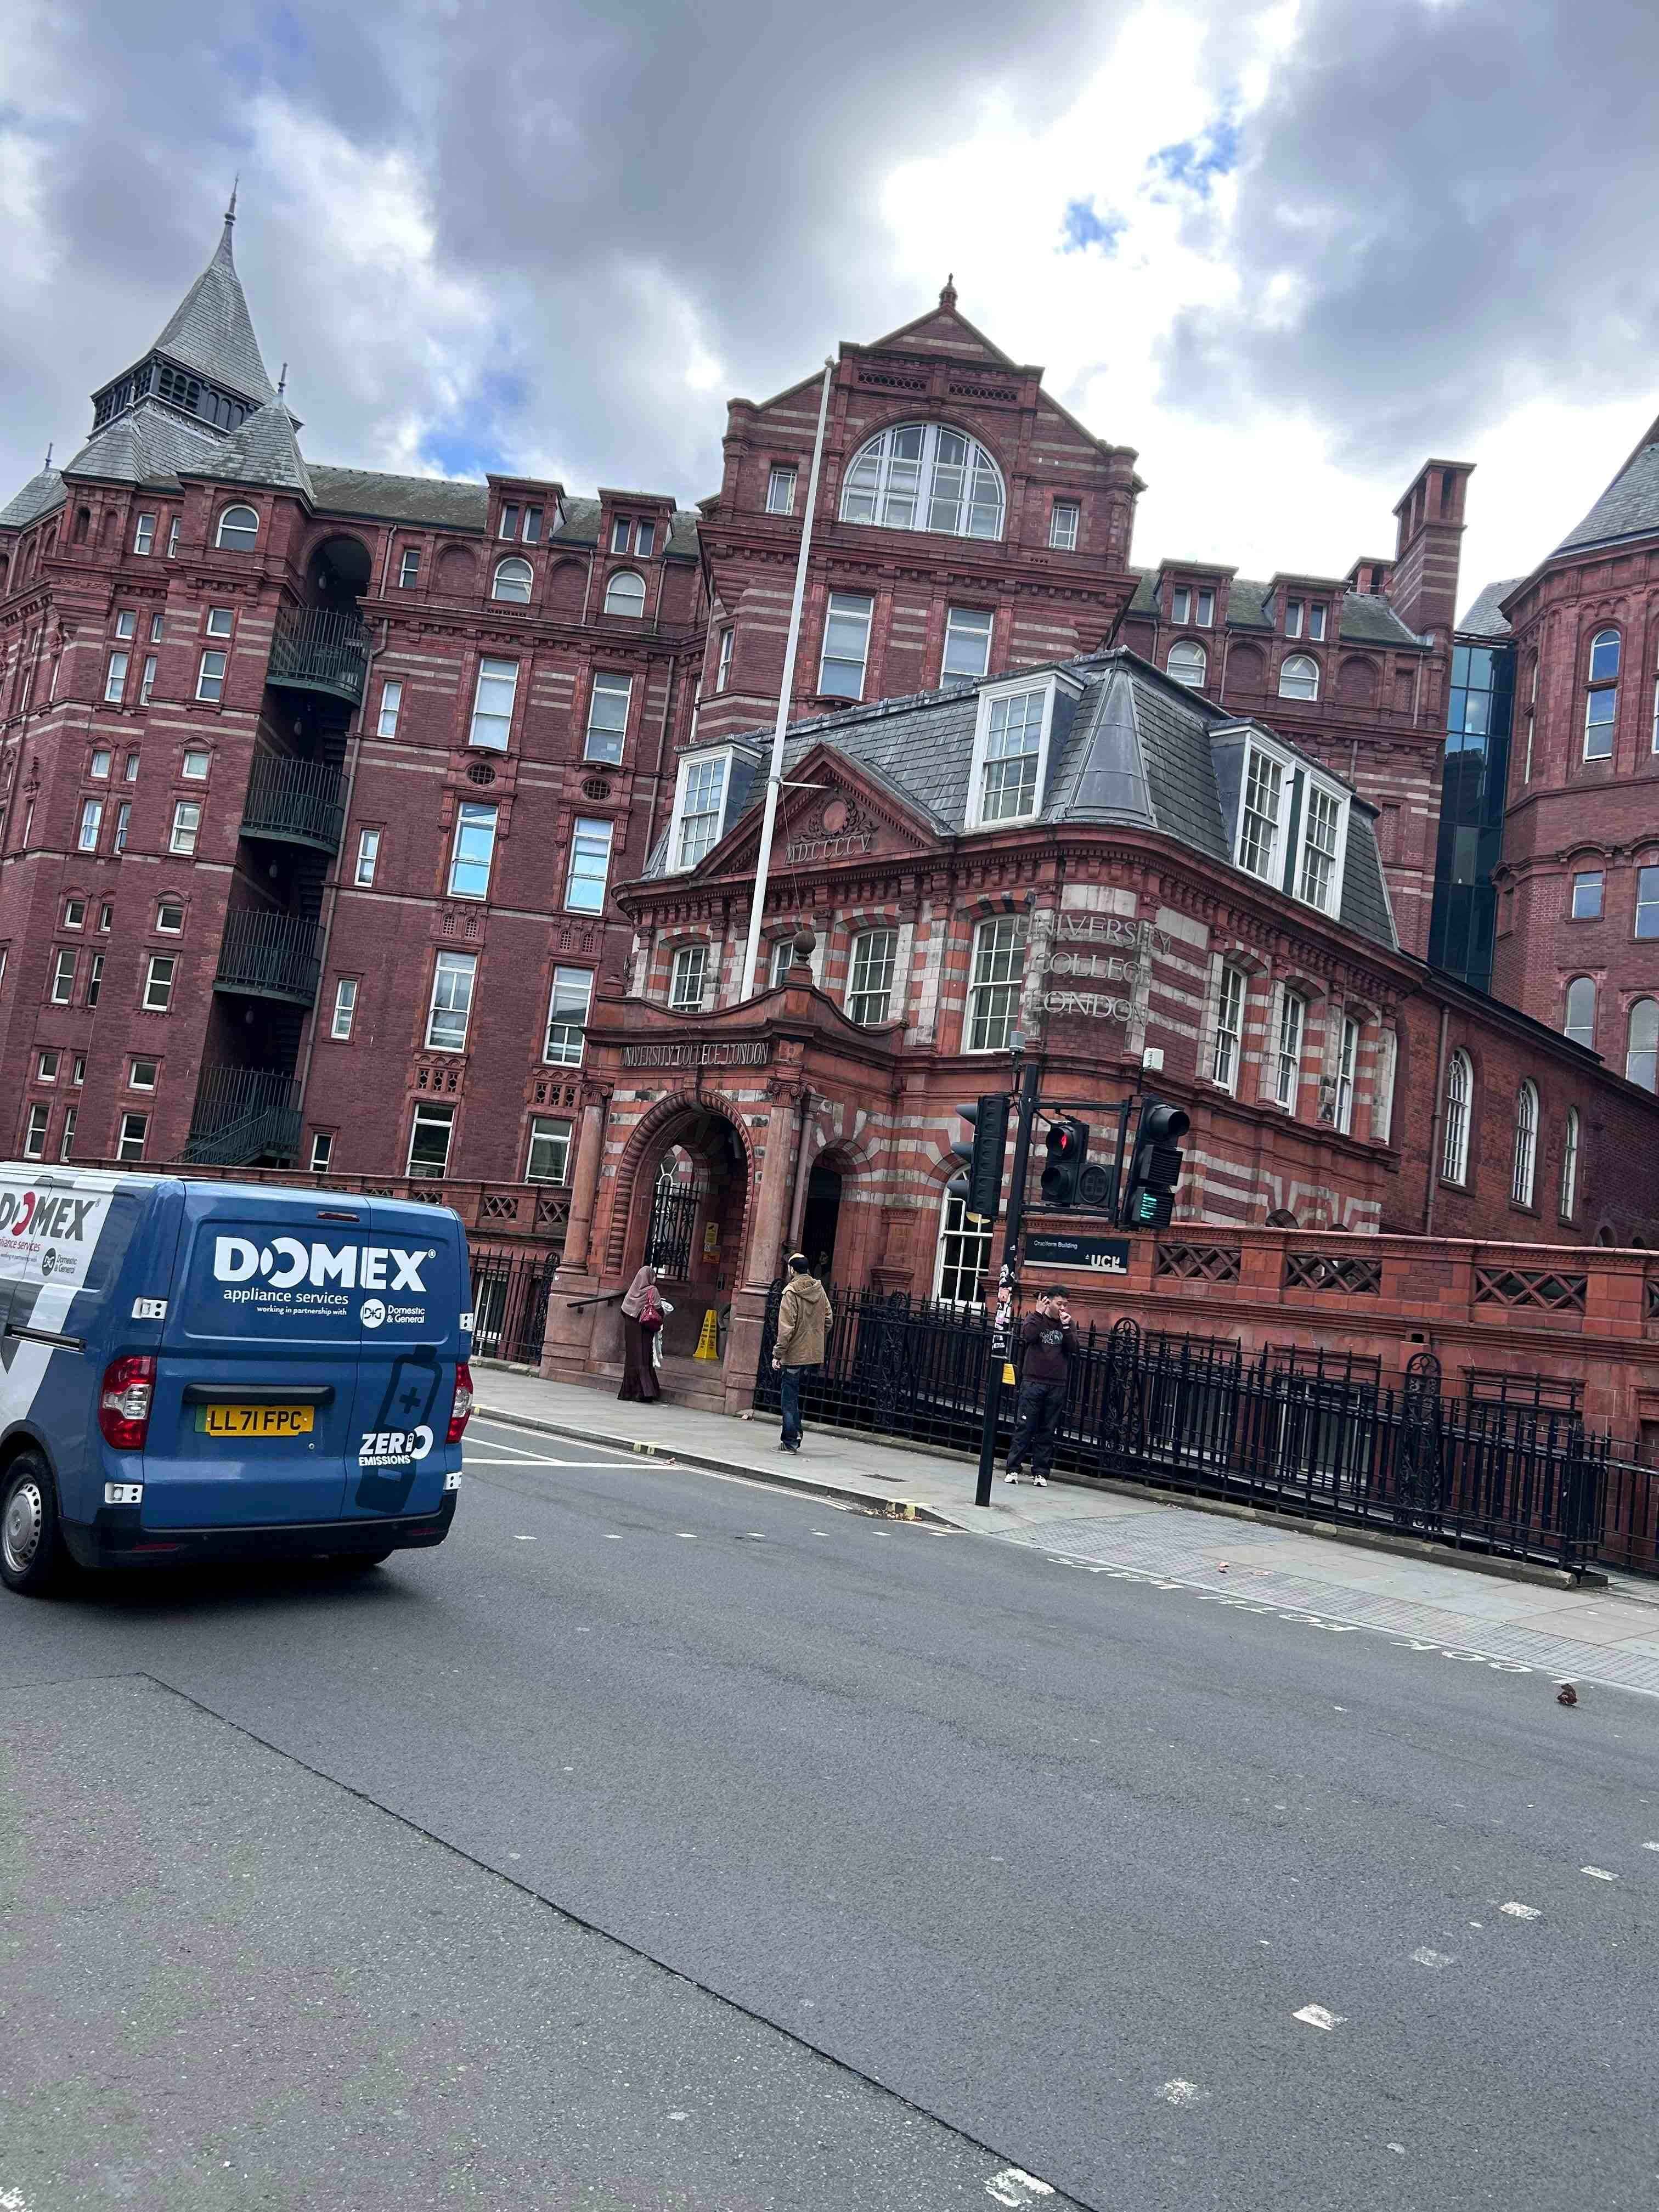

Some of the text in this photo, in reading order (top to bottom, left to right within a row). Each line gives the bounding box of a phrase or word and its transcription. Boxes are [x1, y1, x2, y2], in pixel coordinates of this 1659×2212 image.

[783, 833, 872, 865] MDCCCCV
[1015, 913, 1171, 955] UNIVERSITY
[1031, 952, 1151, 988] COLLEGE
[1028, 989, 1148, 1028] LONDON
[620, 1042, 769, 1066] UNIVERSITY COLLEGE LONDON
[223, 1288, 349, 1305] appliance services
[257, 1305, 284, 1314] working
[387, 1305, 425, 1314] Domestic
[395, 1314, 425, 1323] General
[210, 1410, 302, 1431] LL71 FPC
[358, 1425, 434, 1460] ZERO
[358, 1455, 411, 1467] EMISSIONS
